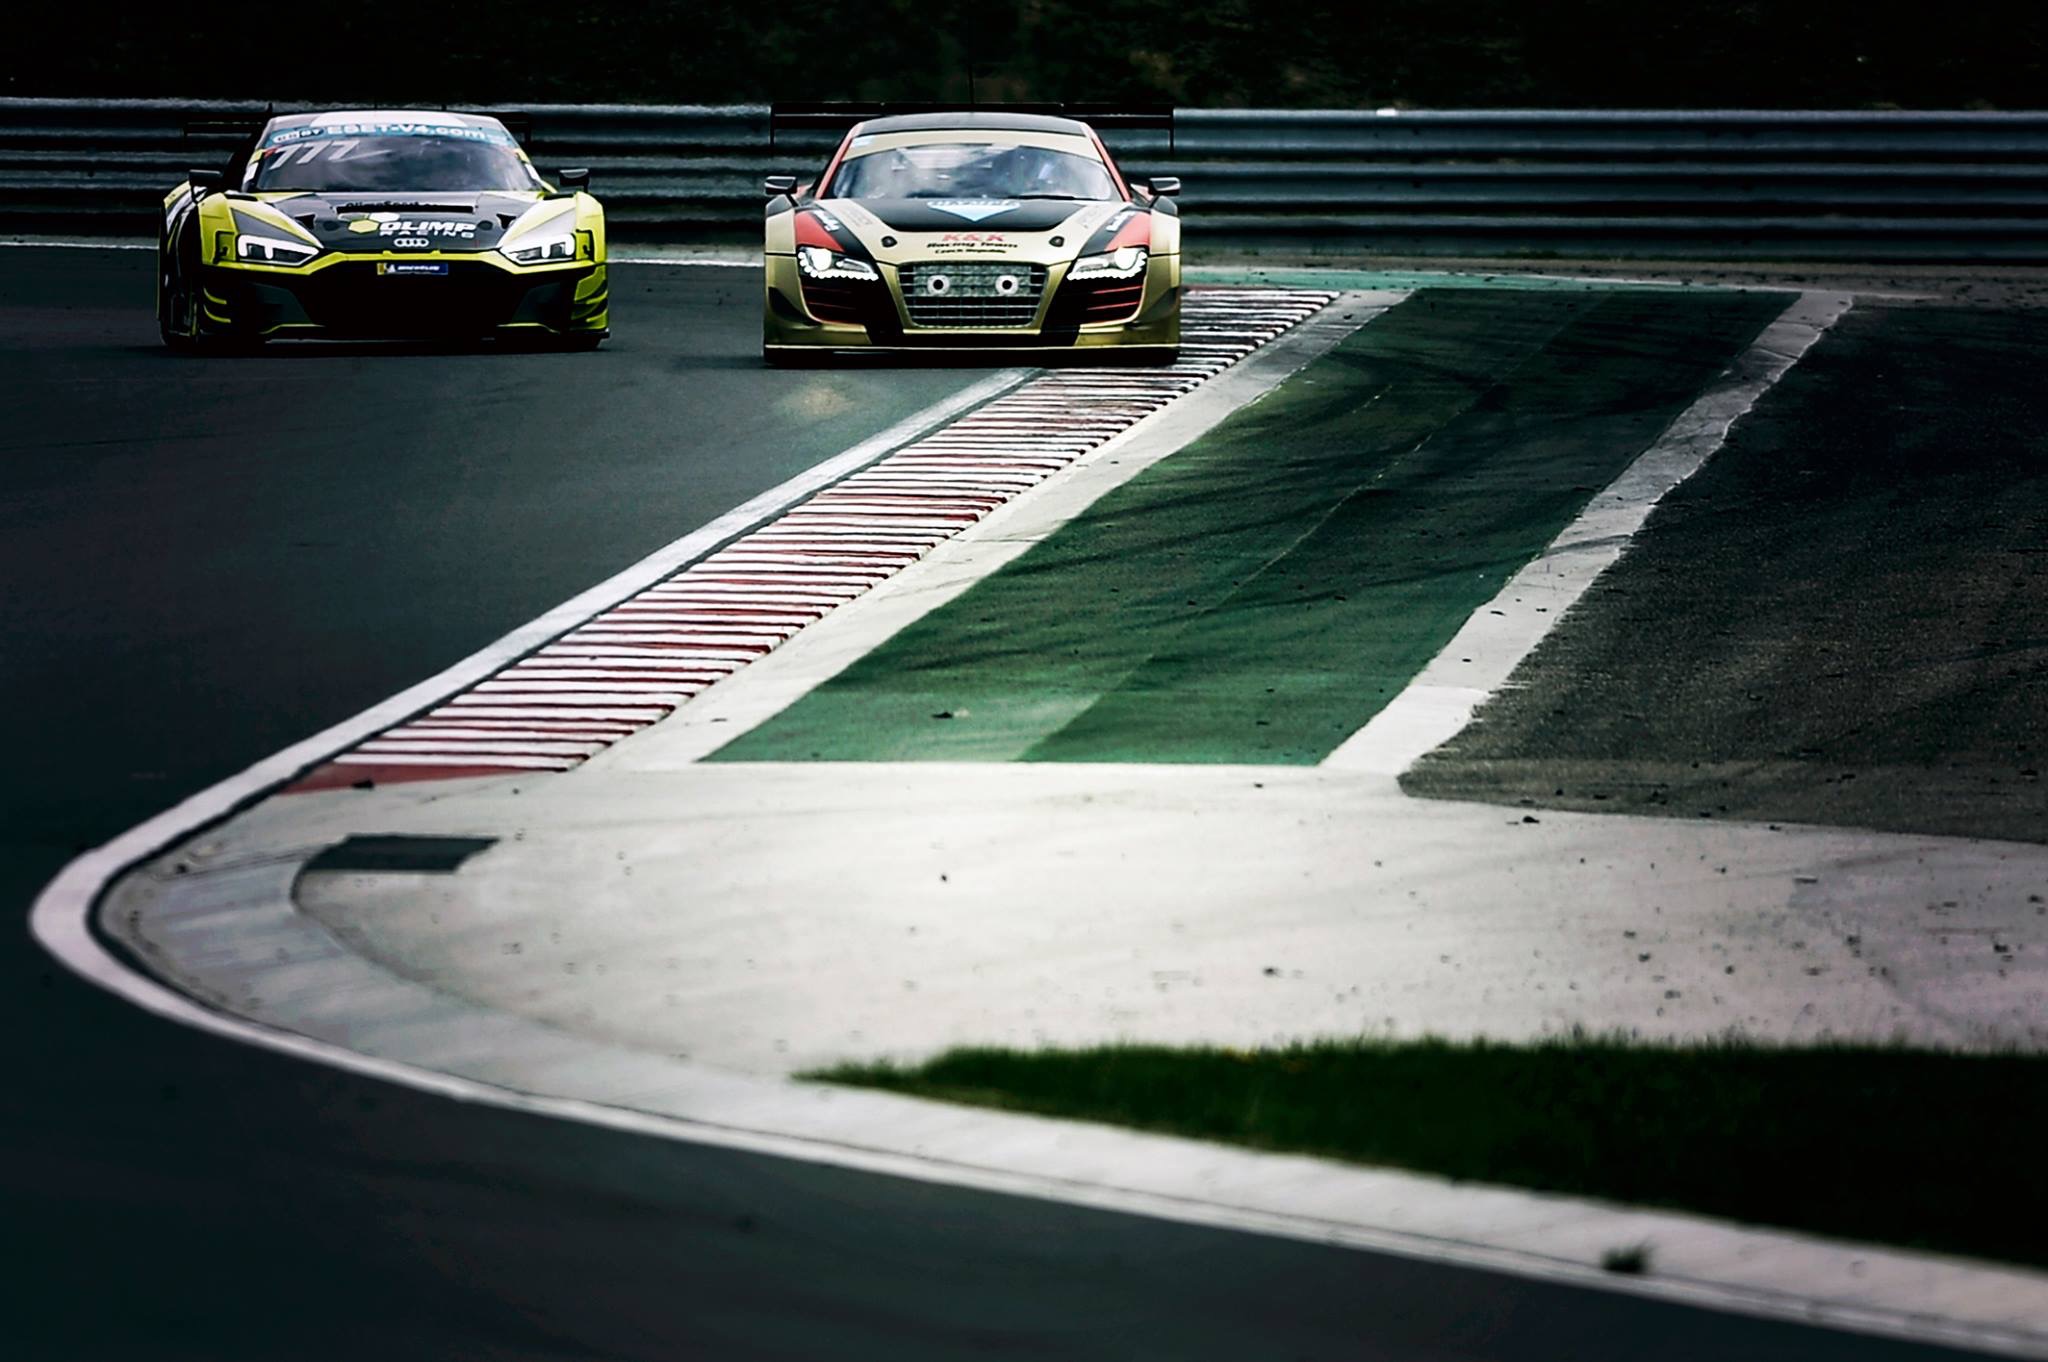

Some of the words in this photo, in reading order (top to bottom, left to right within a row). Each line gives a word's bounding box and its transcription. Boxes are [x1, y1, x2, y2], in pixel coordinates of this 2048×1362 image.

[269, 140, 361, 170] 777
[380, 221, 477, 232] OLIMP
[380, 230, 475, 238] RACING
